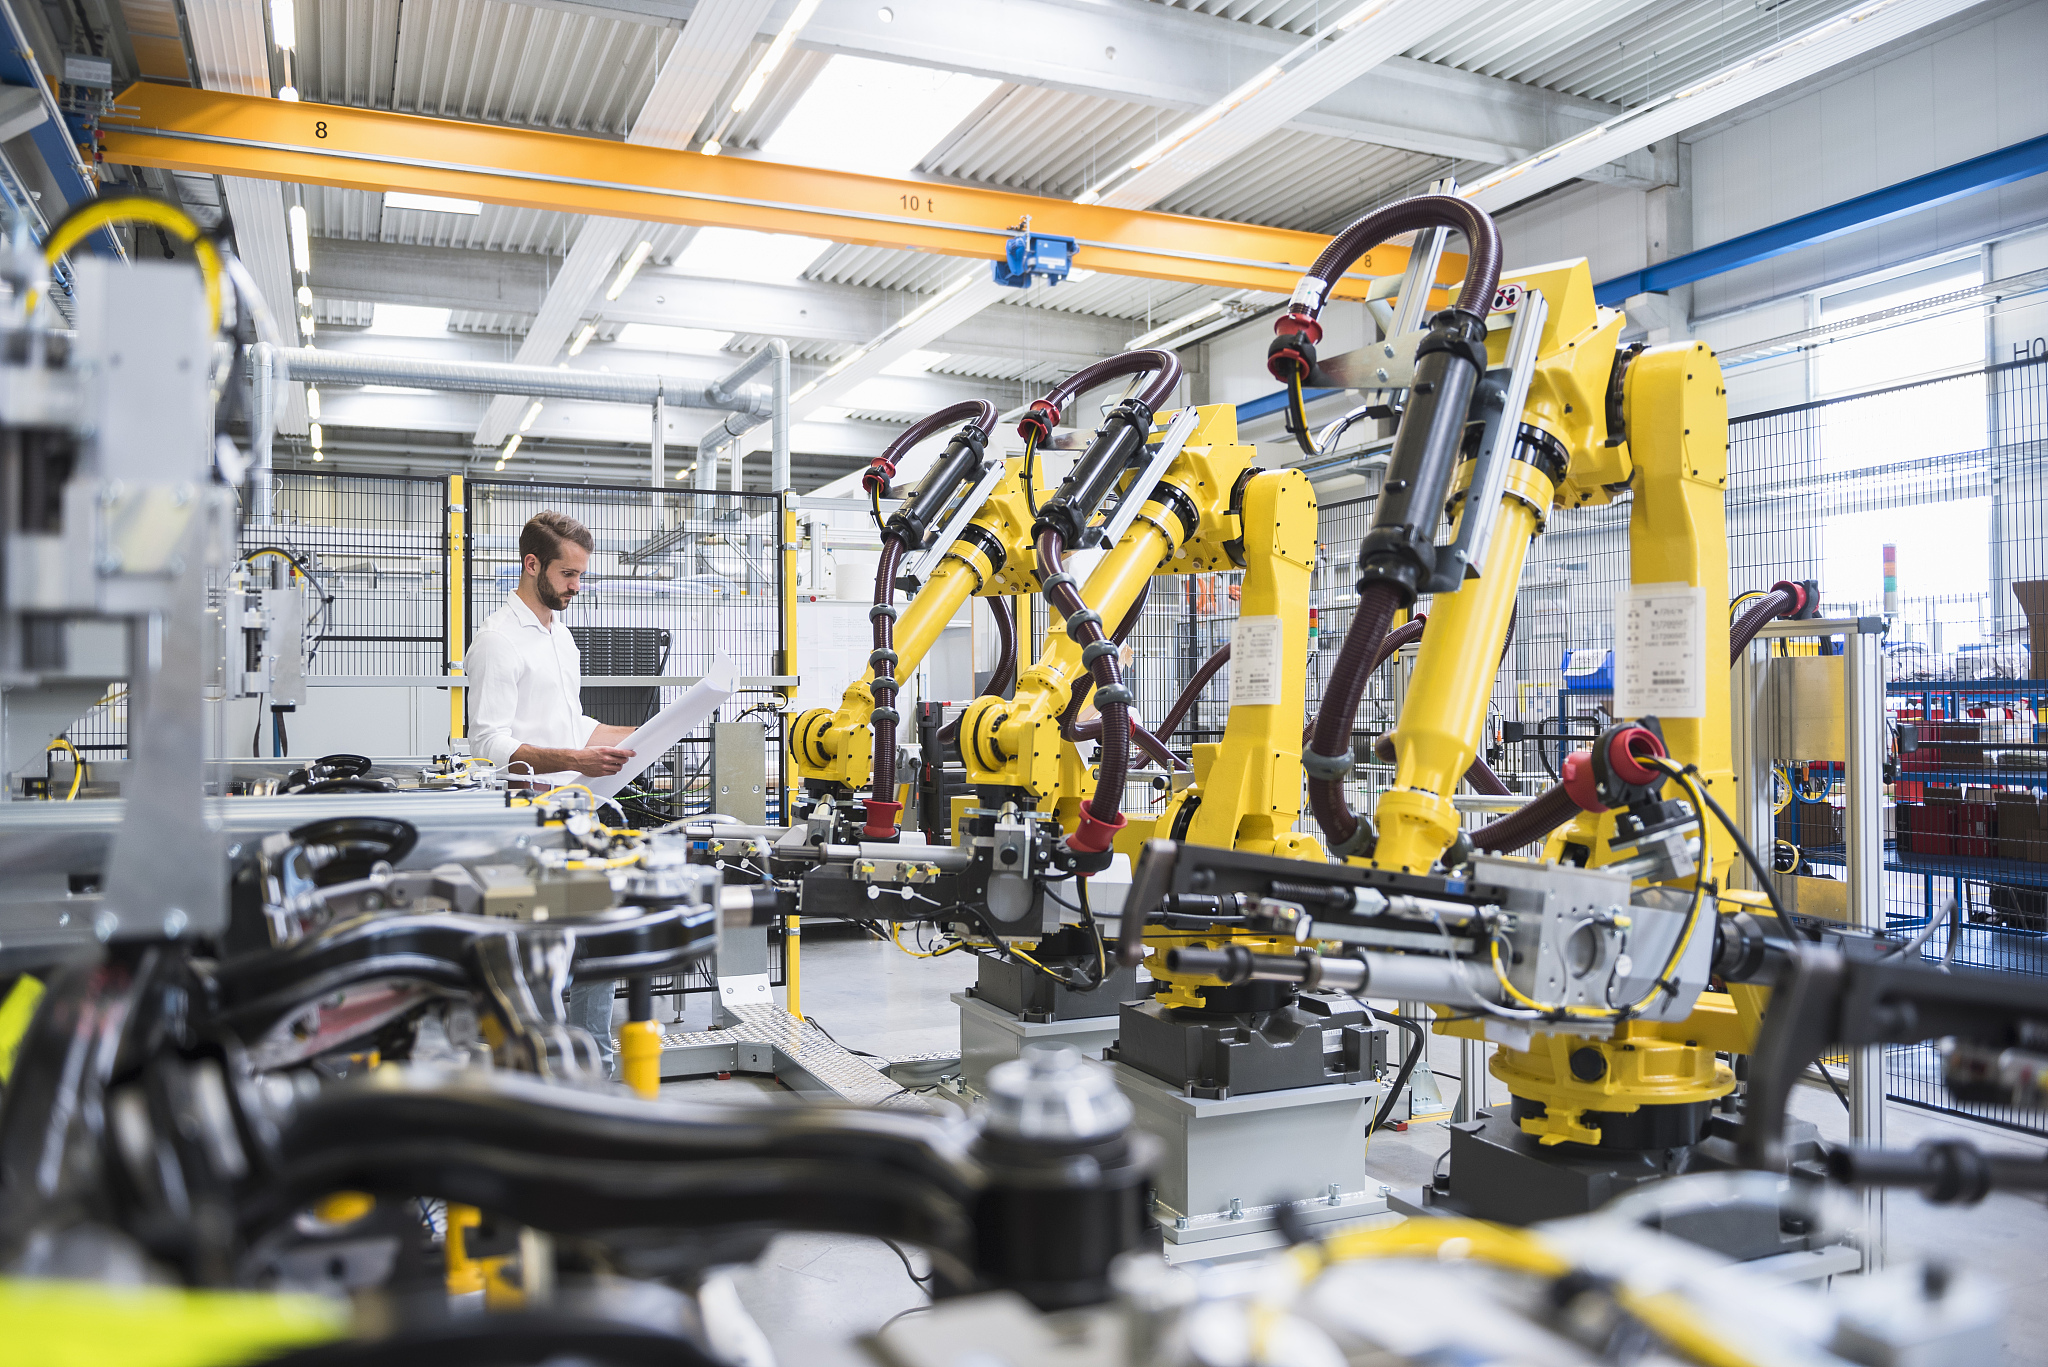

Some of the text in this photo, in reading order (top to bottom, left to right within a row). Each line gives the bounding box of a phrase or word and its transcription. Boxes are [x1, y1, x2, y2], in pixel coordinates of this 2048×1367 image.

[315, 121, 328, 139] 8
[900, 194, 934, 213] 10 t
[1364, 254, 1372, 268] 8
